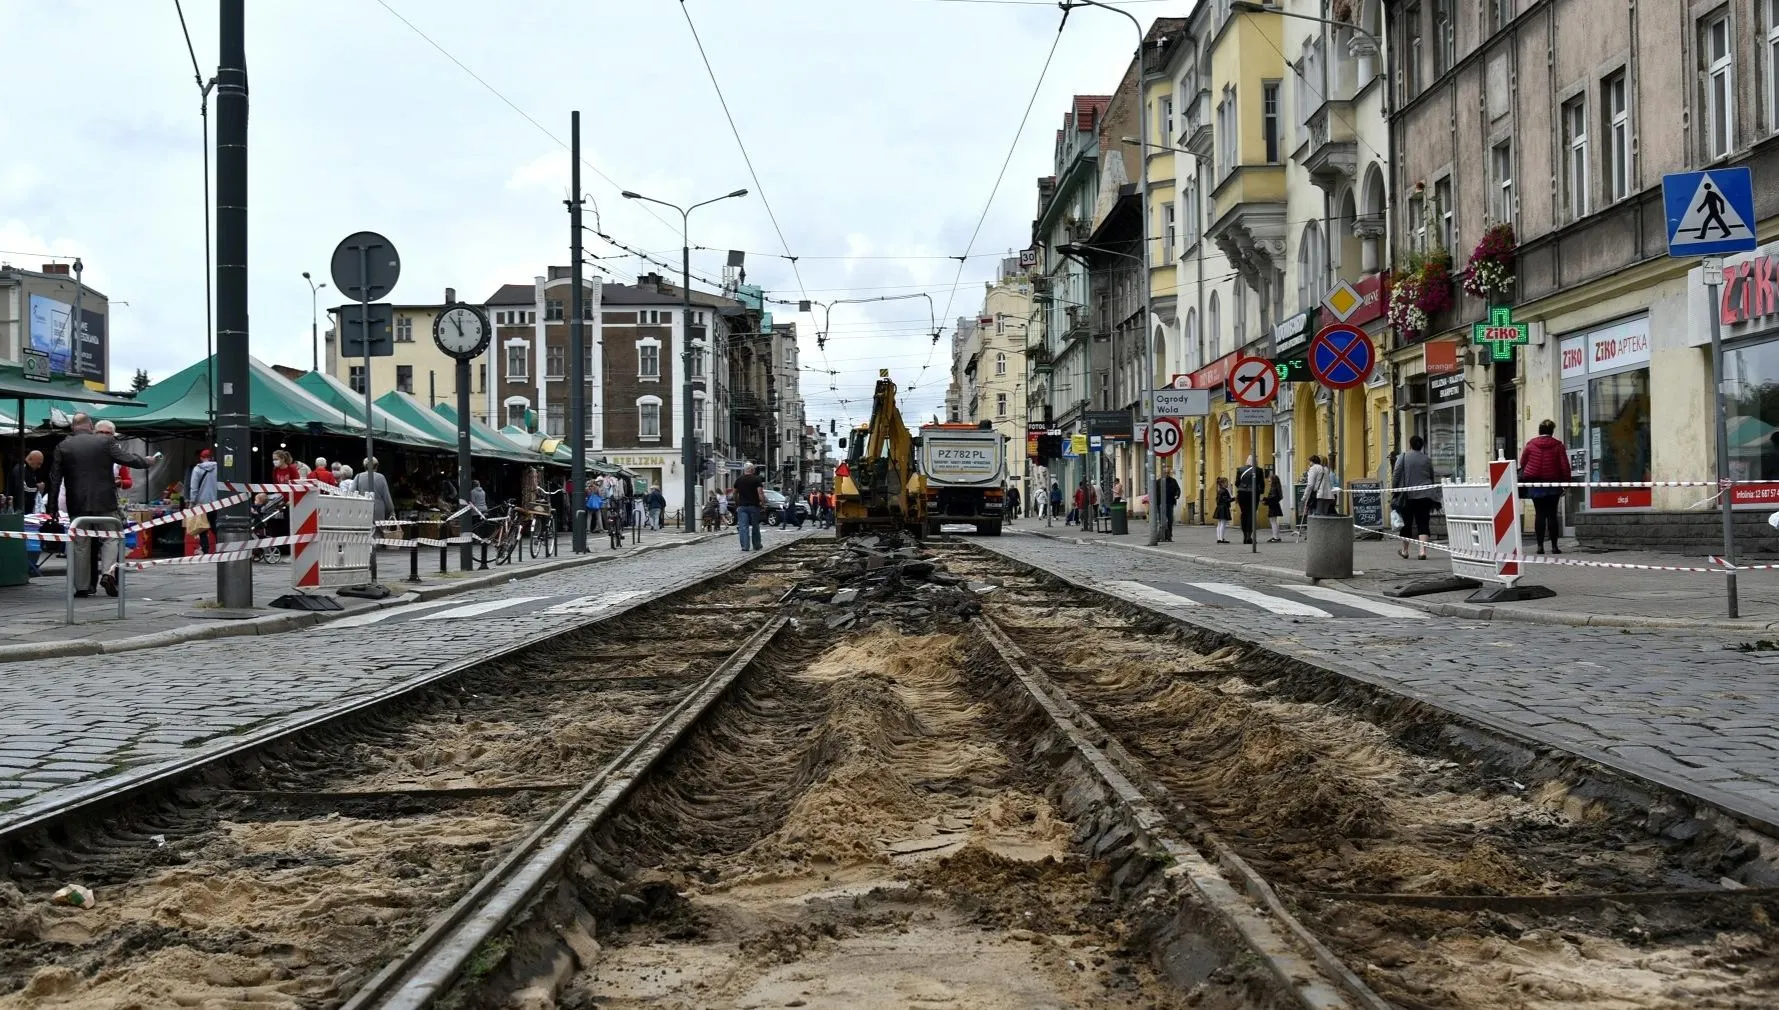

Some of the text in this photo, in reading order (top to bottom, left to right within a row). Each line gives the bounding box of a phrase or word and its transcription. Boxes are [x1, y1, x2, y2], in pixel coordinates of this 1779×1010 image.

[1022, 253, 1035, 262] 30
[1720, 254, 1779, 326] ZiK
[1617, 333, 1648, 357] APTEKA
[1427, 363, 1454, 371] orange
[1156, 395, 1189, 405] Ogrody
[1157, 406, 1179, 414] Wola
[1153, 428, 1177, 447] 30
[938, 449, 985, 459] PZ 782 PL
[1755, 489, 1761, 498] 12
[1761, 488, 1770, 498] 687
